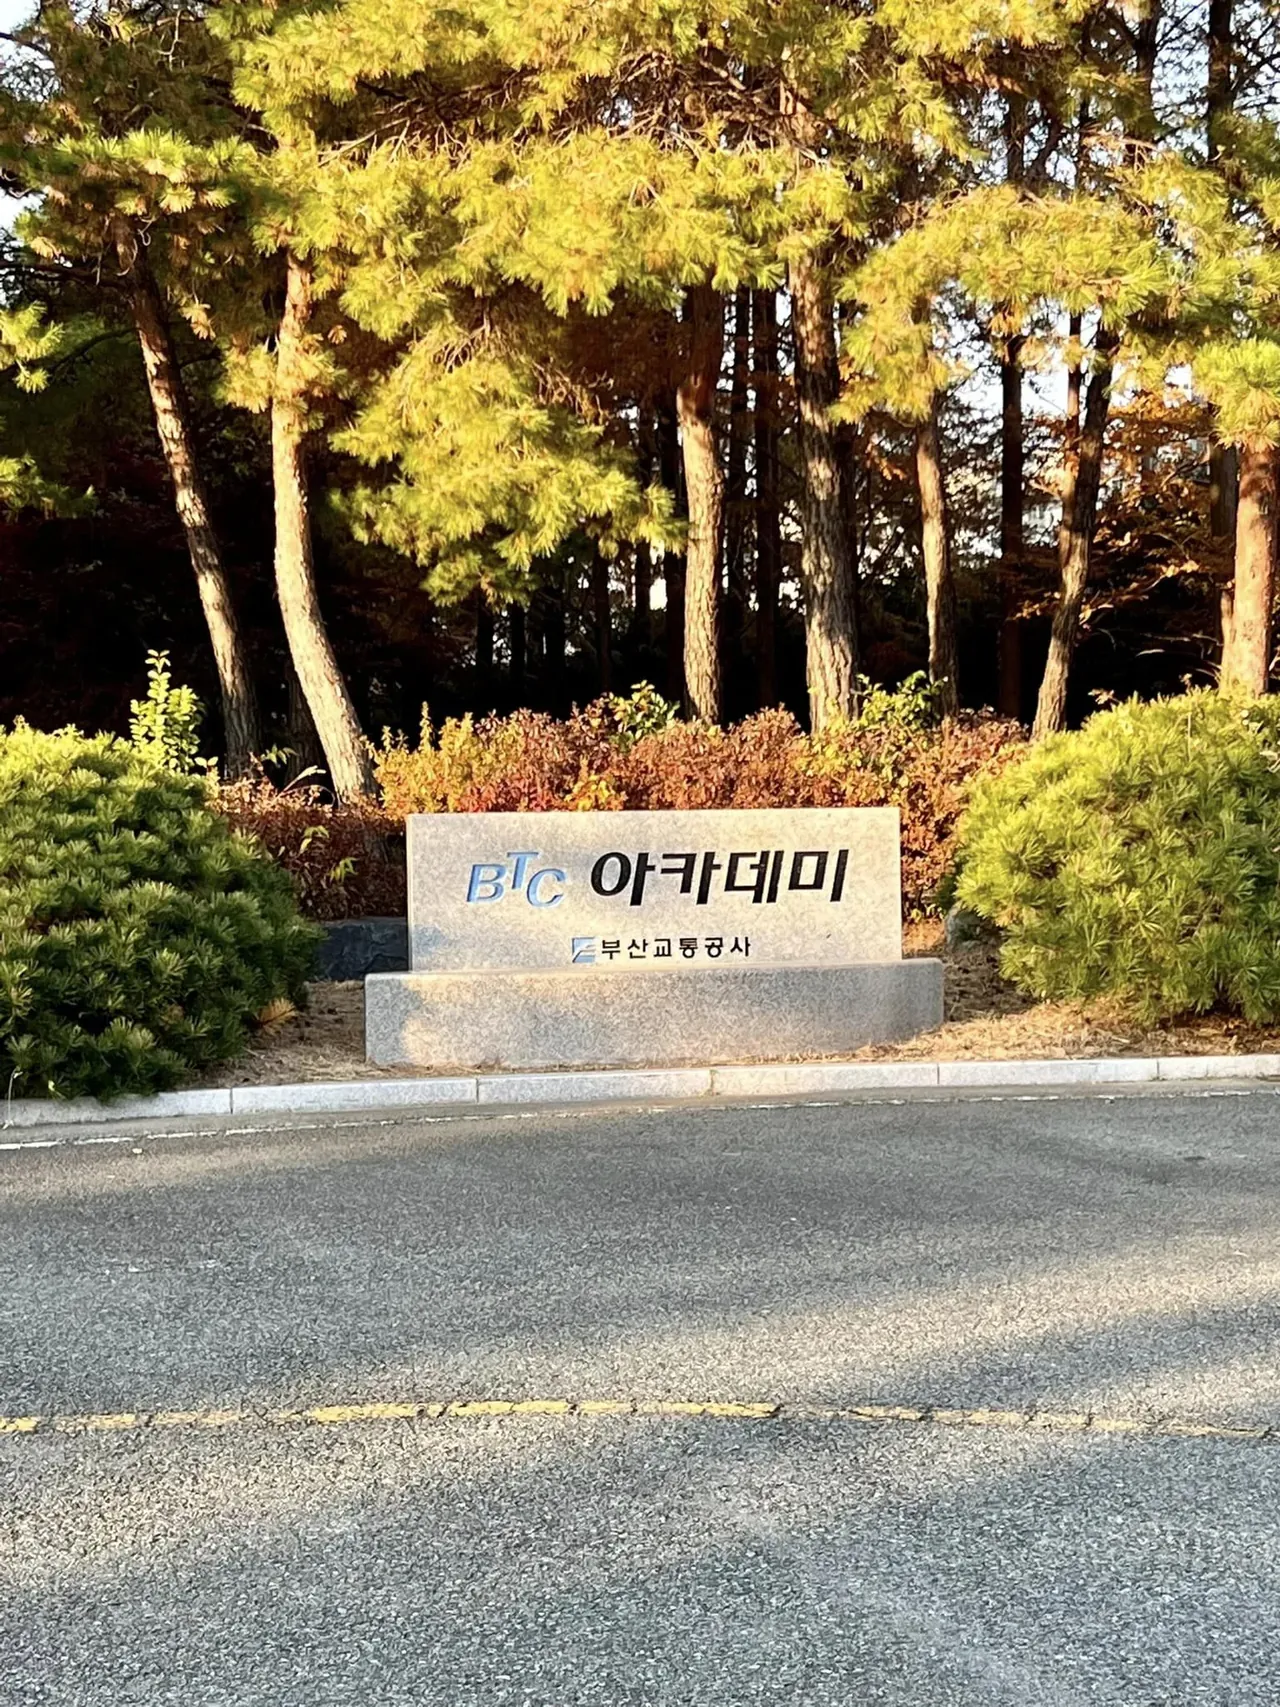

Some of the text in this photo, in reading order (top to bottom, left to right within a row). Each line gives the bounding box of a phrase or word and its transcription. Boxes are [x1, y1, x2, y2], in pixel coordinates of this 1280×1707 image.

[466, 849, 849, 907] BTC 아카데미
[601, 936, 751, 960] 부산교통공사
